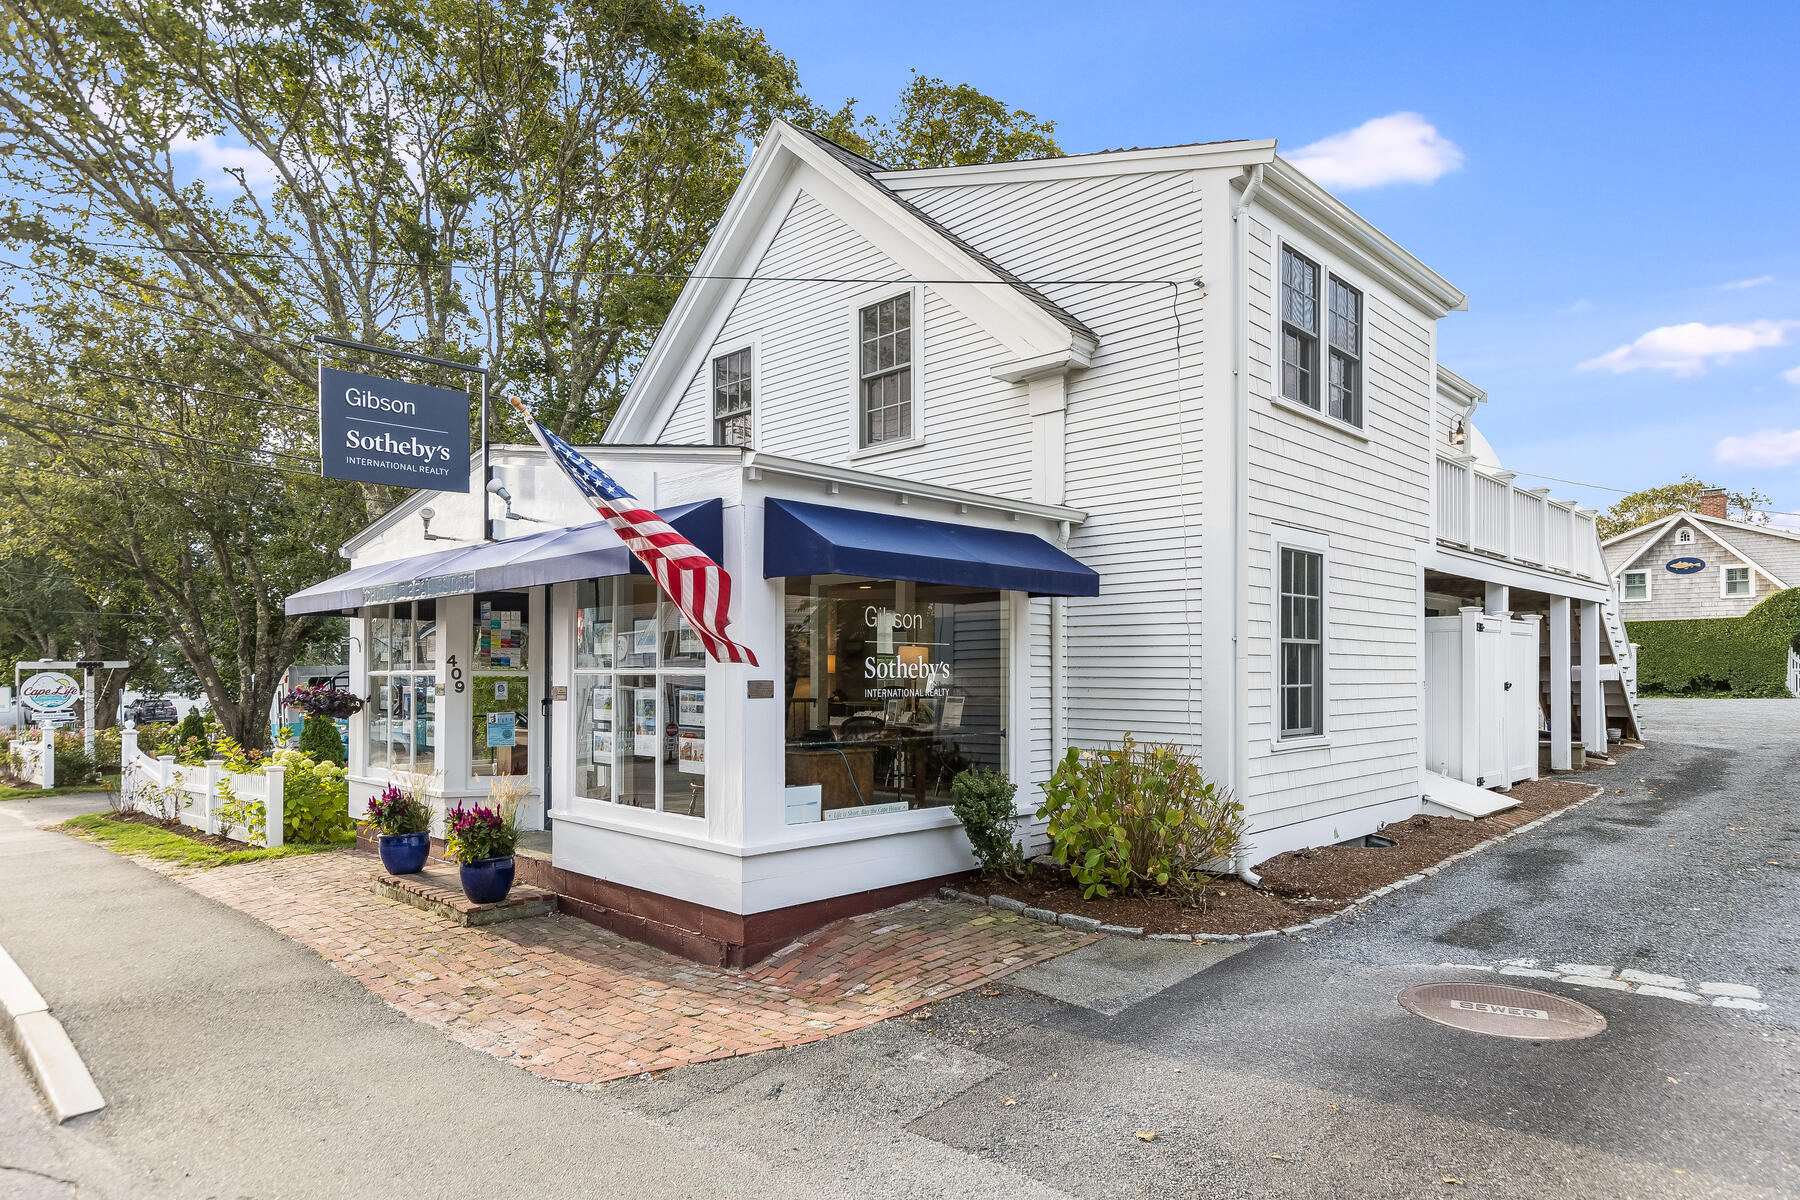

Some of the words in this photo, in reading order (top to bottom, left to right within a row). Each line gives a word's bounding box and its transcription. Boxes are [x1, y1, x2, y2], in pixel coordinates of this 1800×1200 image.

[345, 387, 416, 416] Gibson
[346, 429, 451, 463] Sotheby's
[346, 456, 417, 473] INTERNATIONAL
[419, 465, 449, 476] REALTY
[446, 654, 465, 694] 409
[864, 654, 951, 683] Sotheby's
[23, 686, 51, 699] Cape
[52, 685, 78, 699] Life
[864, 688, 924, 699] INTERNATIONAL
[1460, 1002, 1538, 1017] SEWER
